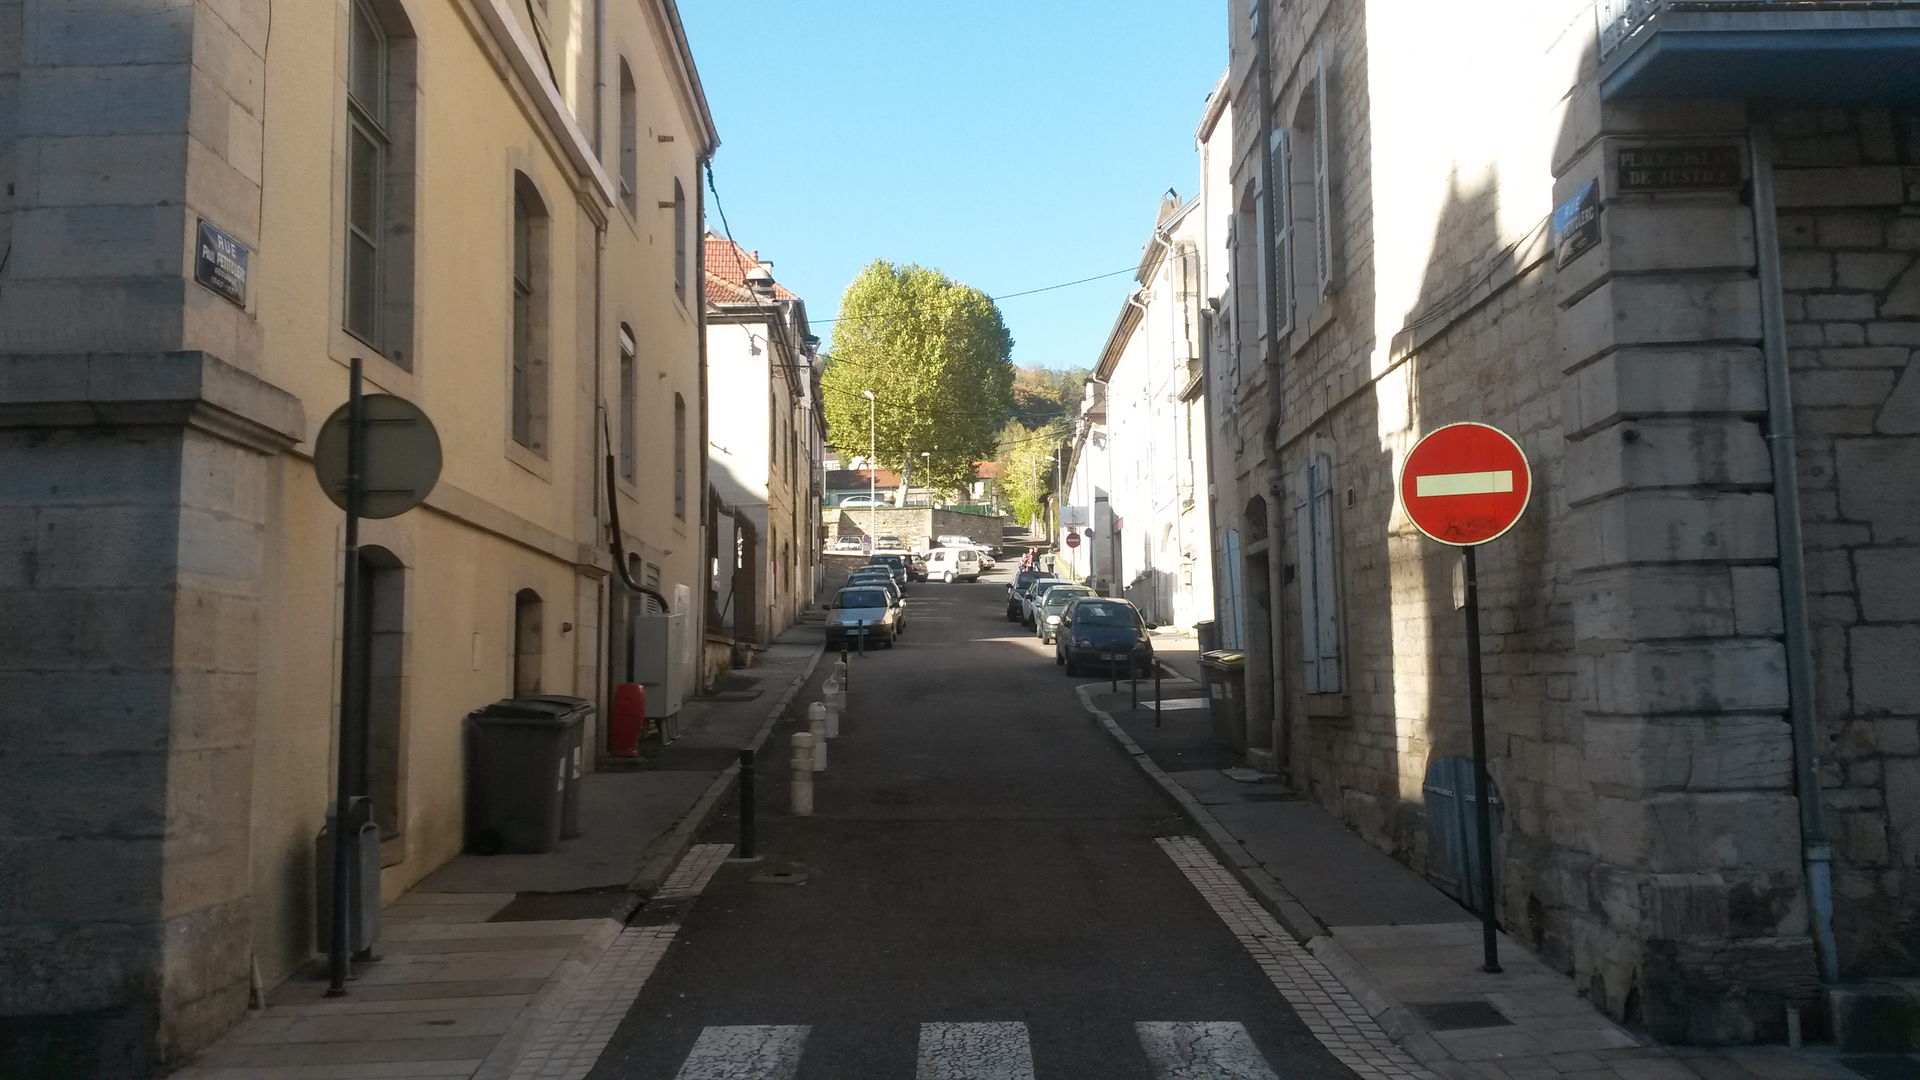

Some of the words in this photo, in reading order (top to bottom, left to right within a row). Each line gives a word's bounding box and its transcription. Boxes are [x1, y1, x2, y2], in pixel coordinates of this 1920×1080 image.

[1630, 170, 1651, 185] DE
[1564, 196, 1581, 218] RUE
[202, 244, 216, 264] PAUL
[217, 234, 236, 259] RUE
